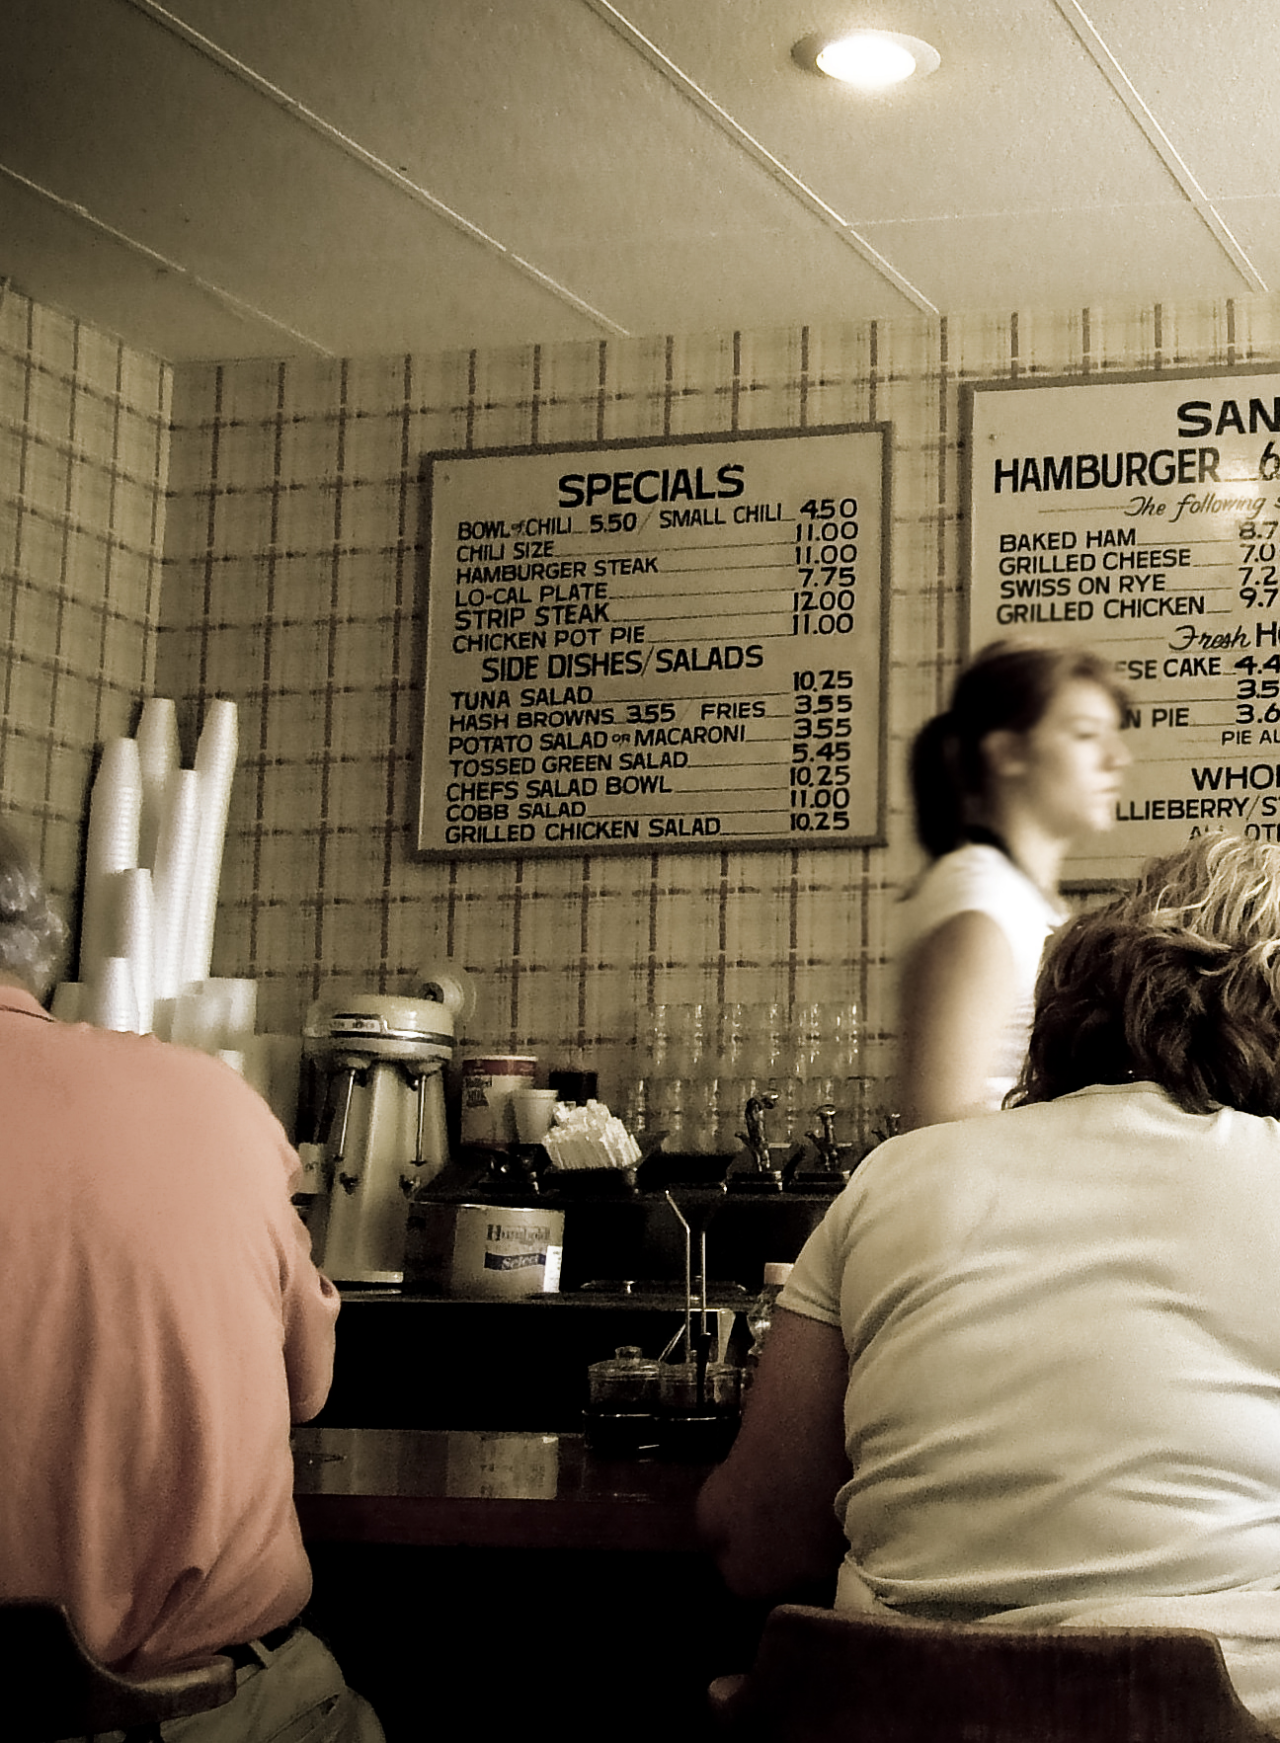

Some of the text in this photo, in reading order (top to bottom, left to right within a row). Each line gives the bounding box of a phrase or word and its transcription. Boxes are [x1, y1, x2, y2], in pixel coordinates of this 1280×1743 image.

[558, 463, 744, 508] SPECIALS
[994, 447, 1222, 494] HAMBURGER
[458, 503, 782, 541] BOWL CHILI 5.50 SMALL CHILI
[1123, 495, 1165, 517] The
[1168, 492, 1267, 523] following
[456, 520, 859, 563] CHILI SIZE 11.00
[999, 531, 1077, 554] BAKED
[1086, 527, 1137, 550] HAM
[456, 544, 858, 585] HAMBURGER STEAK 11.00
[998, 553, 1097, 577] GRILLED
[1102, 548, 1192, 571] CHEESE
[455, 566, 856, 607] LO-CAL PLATE 7.75
[1000, 577, 1071, 600] SWISS
[1077, 575, 1111, 596] ON
[1118, 573, 1167, 594] RYE
[455, 602, 611, 631] STRIP STEAK
[996, 600, 1094, 625] GRILLED
[1103, 595, 1206, 620] CHICKEN
[452, 612, 854, 654] CHICKEN POT PIE 11.00
[1167, 623, 1252, 651] Fresh
[481, 655, 539, 682] SIDE
[1163, 656, 1222, 679] CAKE
[450, 669, 854, 711] TUNA SALAD 10.25
[449, 694, 853, 733] HASH BROWNS FRIES 3.55
[1151, 707, 1190, 728] PIE
[449, 724, 745, 755] POTATO SALAD MACARONI
[1221, 729, 1253, 746] PIE
[450, 741, 851, 778] TOSSED GREEN SALAD 5.45
[446, 765, 851, 802] CHEFS SALAD BOWL 10.25
[446, 787, 850, 822] COBB SALAD 11.00
[445, 811, 850, 844] GRILLED CHICKEN SALAD 10.25
